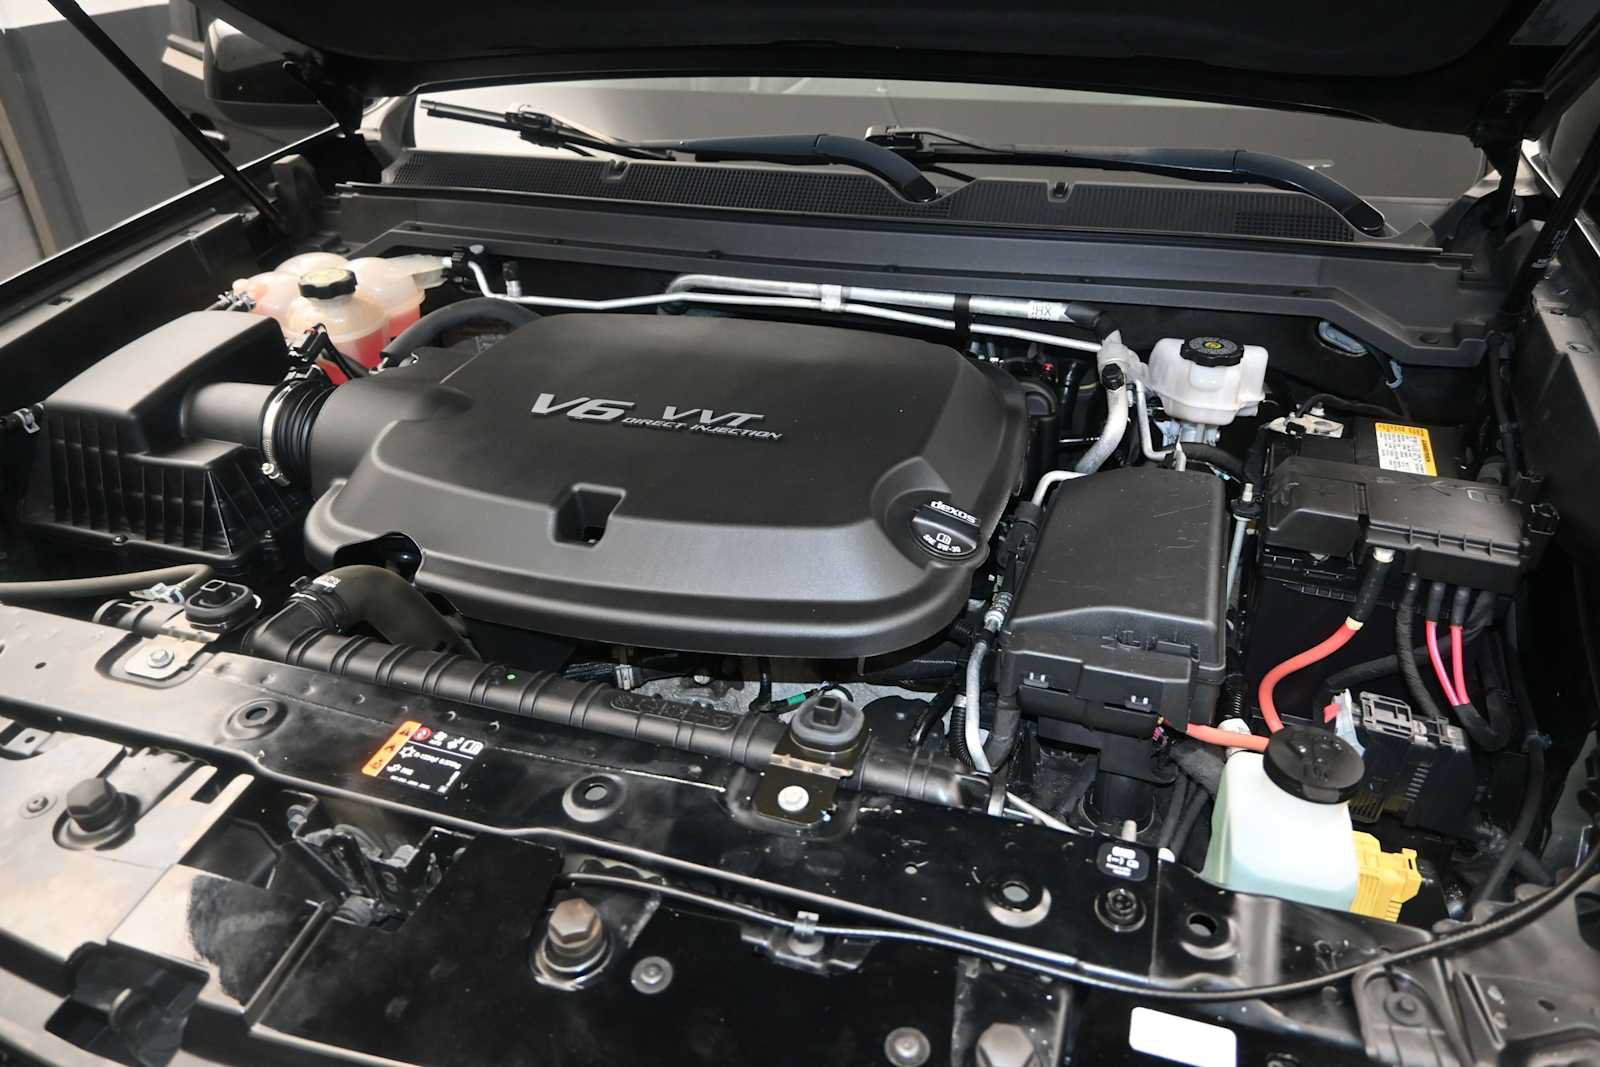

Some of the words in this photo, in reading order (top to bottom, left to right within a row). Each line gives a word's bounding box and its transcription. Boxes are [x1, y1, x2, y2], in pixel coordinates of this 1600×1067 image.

[531, 393, 635, 421] V6
[662, 405, 765, 427] VVT
[621, 416, 689, 430] DIRECT
[690, 424, 784, 441] INJECTION
[930, 501, 976, 523] dexos
